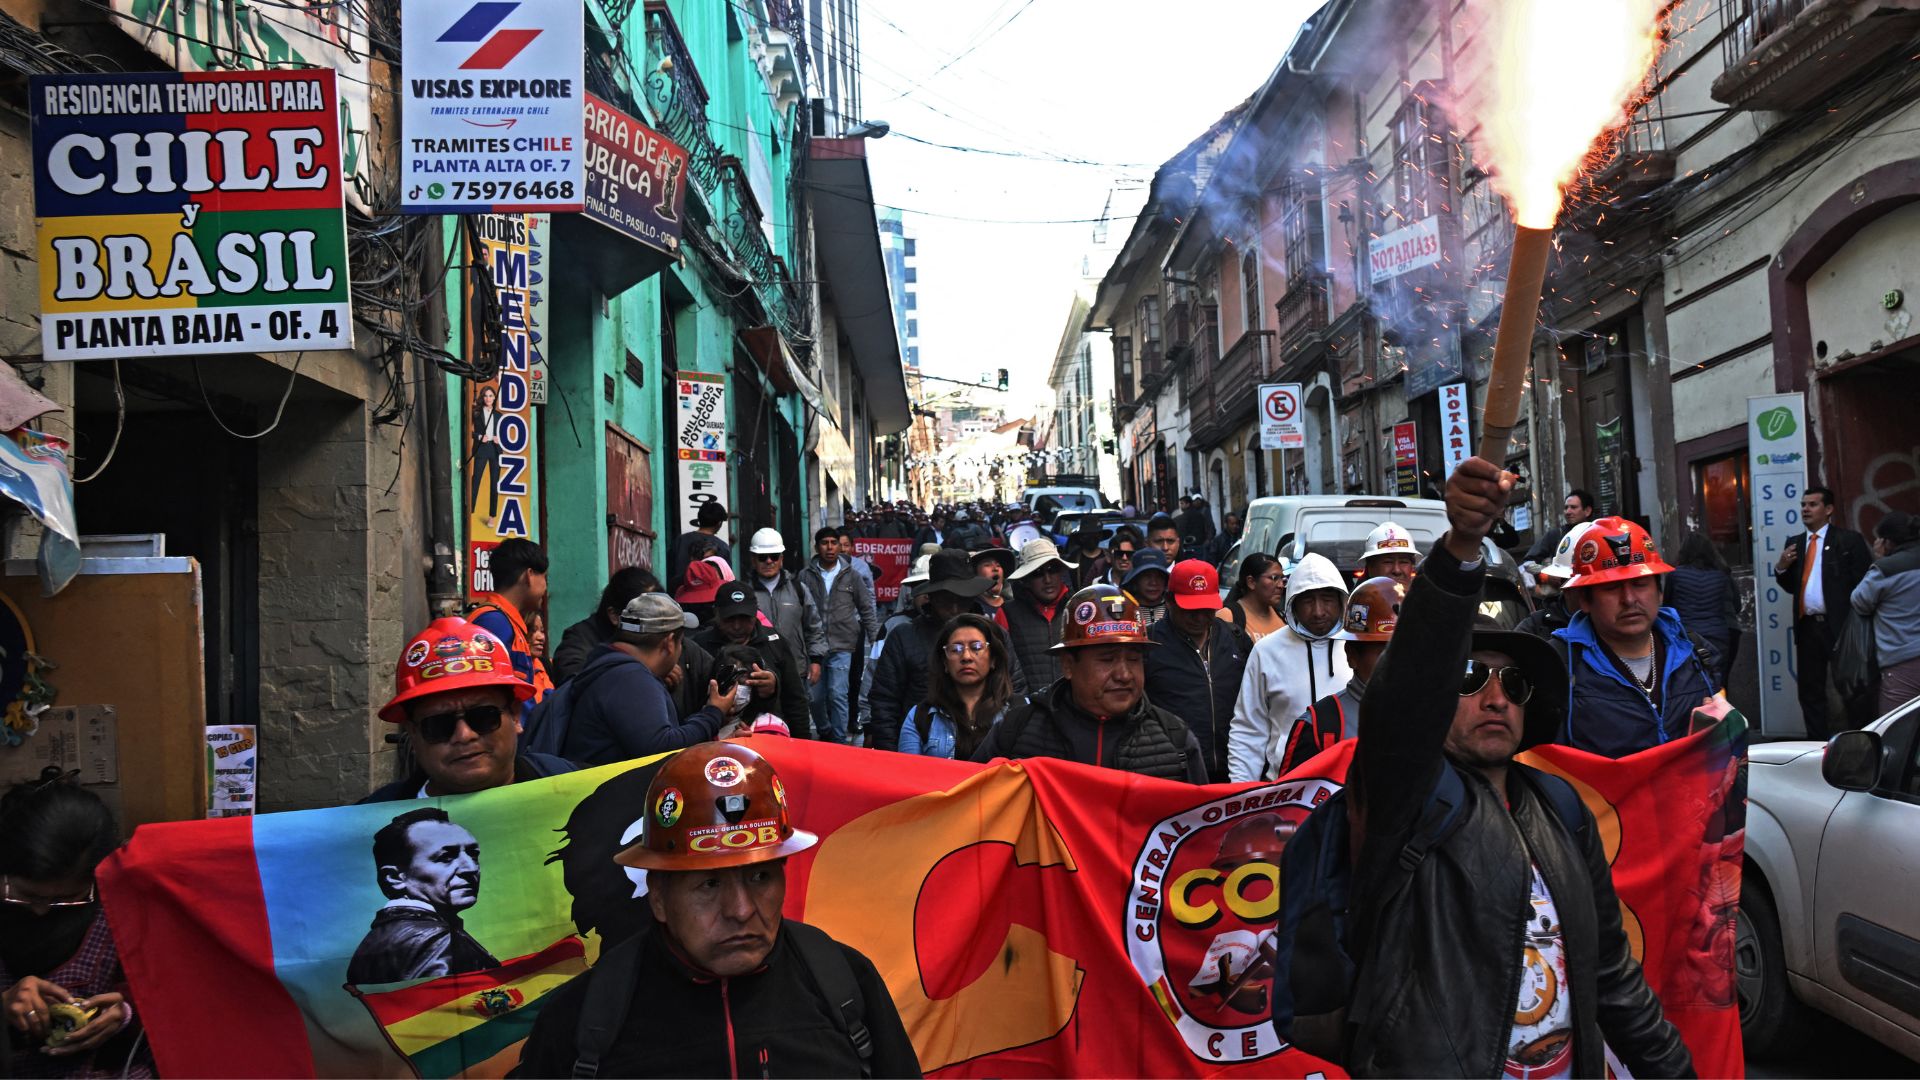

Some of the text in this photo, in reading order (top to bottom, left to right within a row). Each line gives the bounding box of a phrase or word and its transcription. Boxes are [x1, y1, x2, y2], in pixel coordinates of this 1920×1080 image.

[45, 81, 324, 116] RESIDENCIA TEMPORAL PARA
[411, 79, 572, 98] VISAS EXPLORE
[430, 107, 550, 115] TRAMITES EXTRANJERIA CHILE
[411, 137, 573, 153] TRAMITES CHILE
[634, 130, 659, 164] DE
[48, 128, 329, 196] CHILE
[412, 159, 571, 173] PLANTA ALTA OF. 7
[451, 181, 575, 200] 75976468
[601, 178, 619, 204] 15
[182, 204, 201, 228] y
[585, 196, 608, 216] FINAL
[609, 207, 624, 224] DEL
[625, 214, 656, 239] PASILLO
[475, 214, 526, 246] MODAS
[52, 231, 334, 301] BRASIL
[57, 316, 165, 350] PLANTA
[173, 313, 244, 345] BAJA
[269, 311, 311, 341] OF.
[319, 310, 339, 339] 4
[494, 248, 528, 537] MENDOZA
[680, 384, 714, 445] ANILLADOS
[687, 387, 724, 449] FOTOCOPIA
[1446, 386, 1464, 464] NOTARI
[680, 450, 726, 462] COLOR
[1784, 483, 1798, 525] GO
[855, 543, 913, 554] EDERACION
[1762, 485, 1779, 629] SELLOS
[878, 587, 899, 597] PRE
[1096, 624, 1134, 632] PORCO
[422, 659, 494, 679] COB
[710, 765, 738, 774] COB
[689, 828, 719, 837] CENTRAL
[721, 823, 748, 832] OBRERA
[689, 826, 779, 852] COB
[1135, 820, 1192, 943] CENTRAL
[1202, 785, 1306, 823] OBRERA
